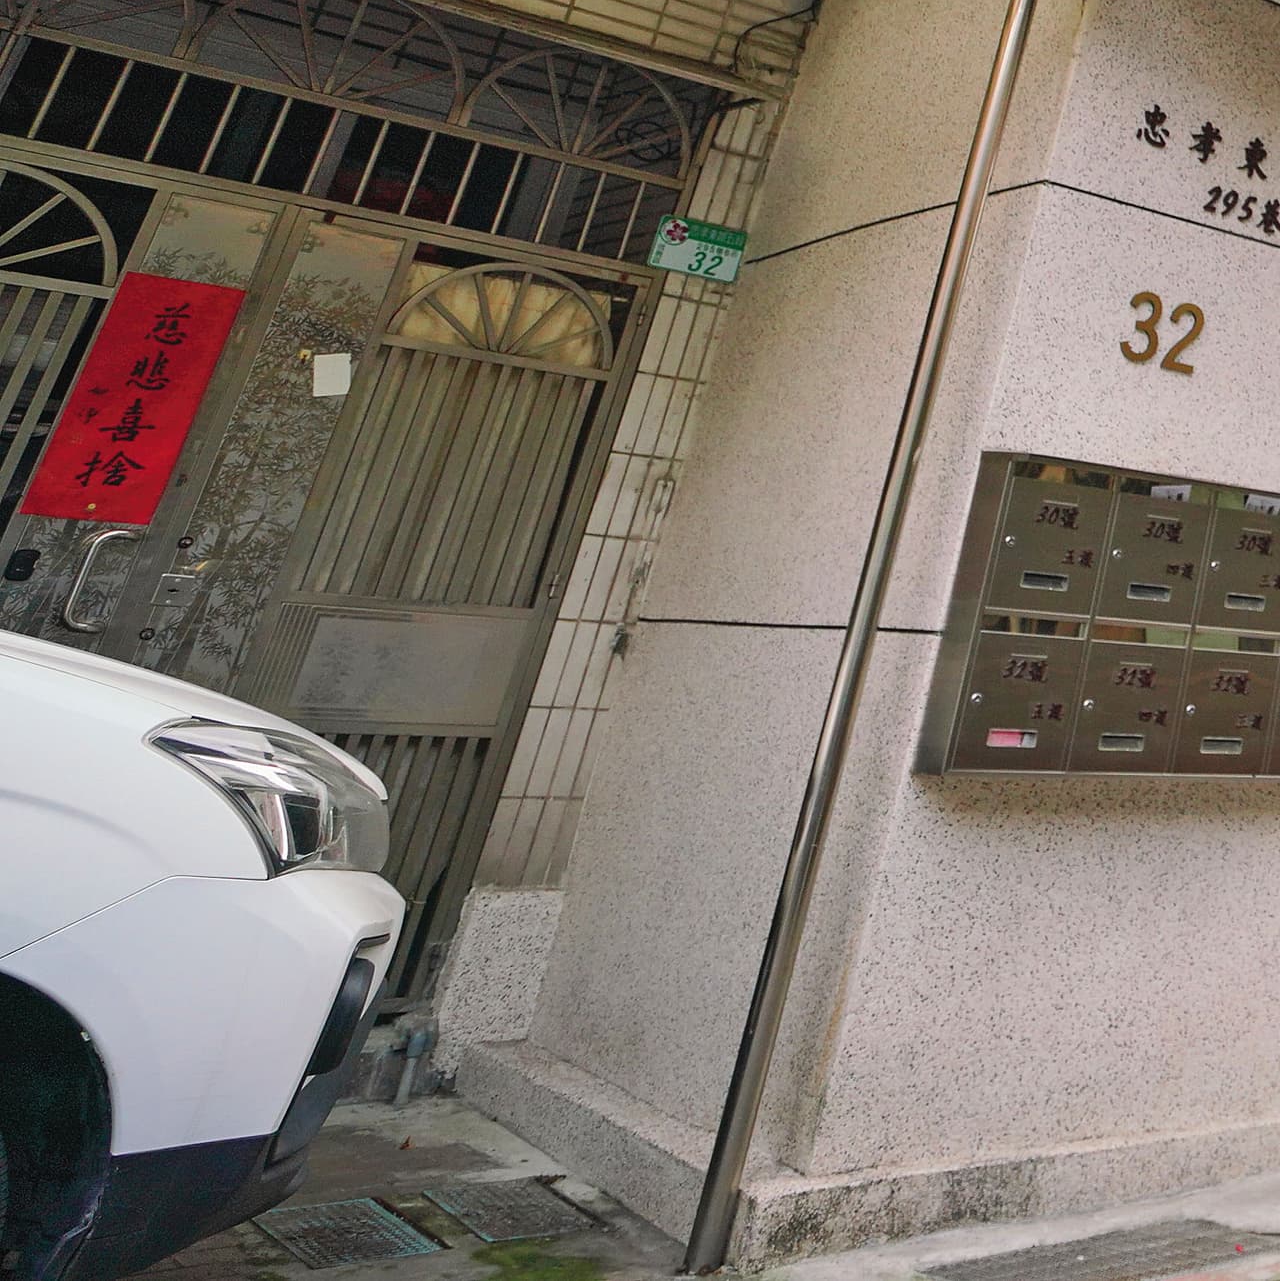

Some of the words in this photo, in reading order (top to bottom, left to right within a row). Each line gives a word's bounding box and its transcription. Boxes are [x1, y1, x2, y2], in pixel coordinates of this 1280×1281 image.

[687, 251, 724, 277] 32
[1119, 290, 1205, 378] 32
[75, 302, 191, 488] 慈悲喜捨
